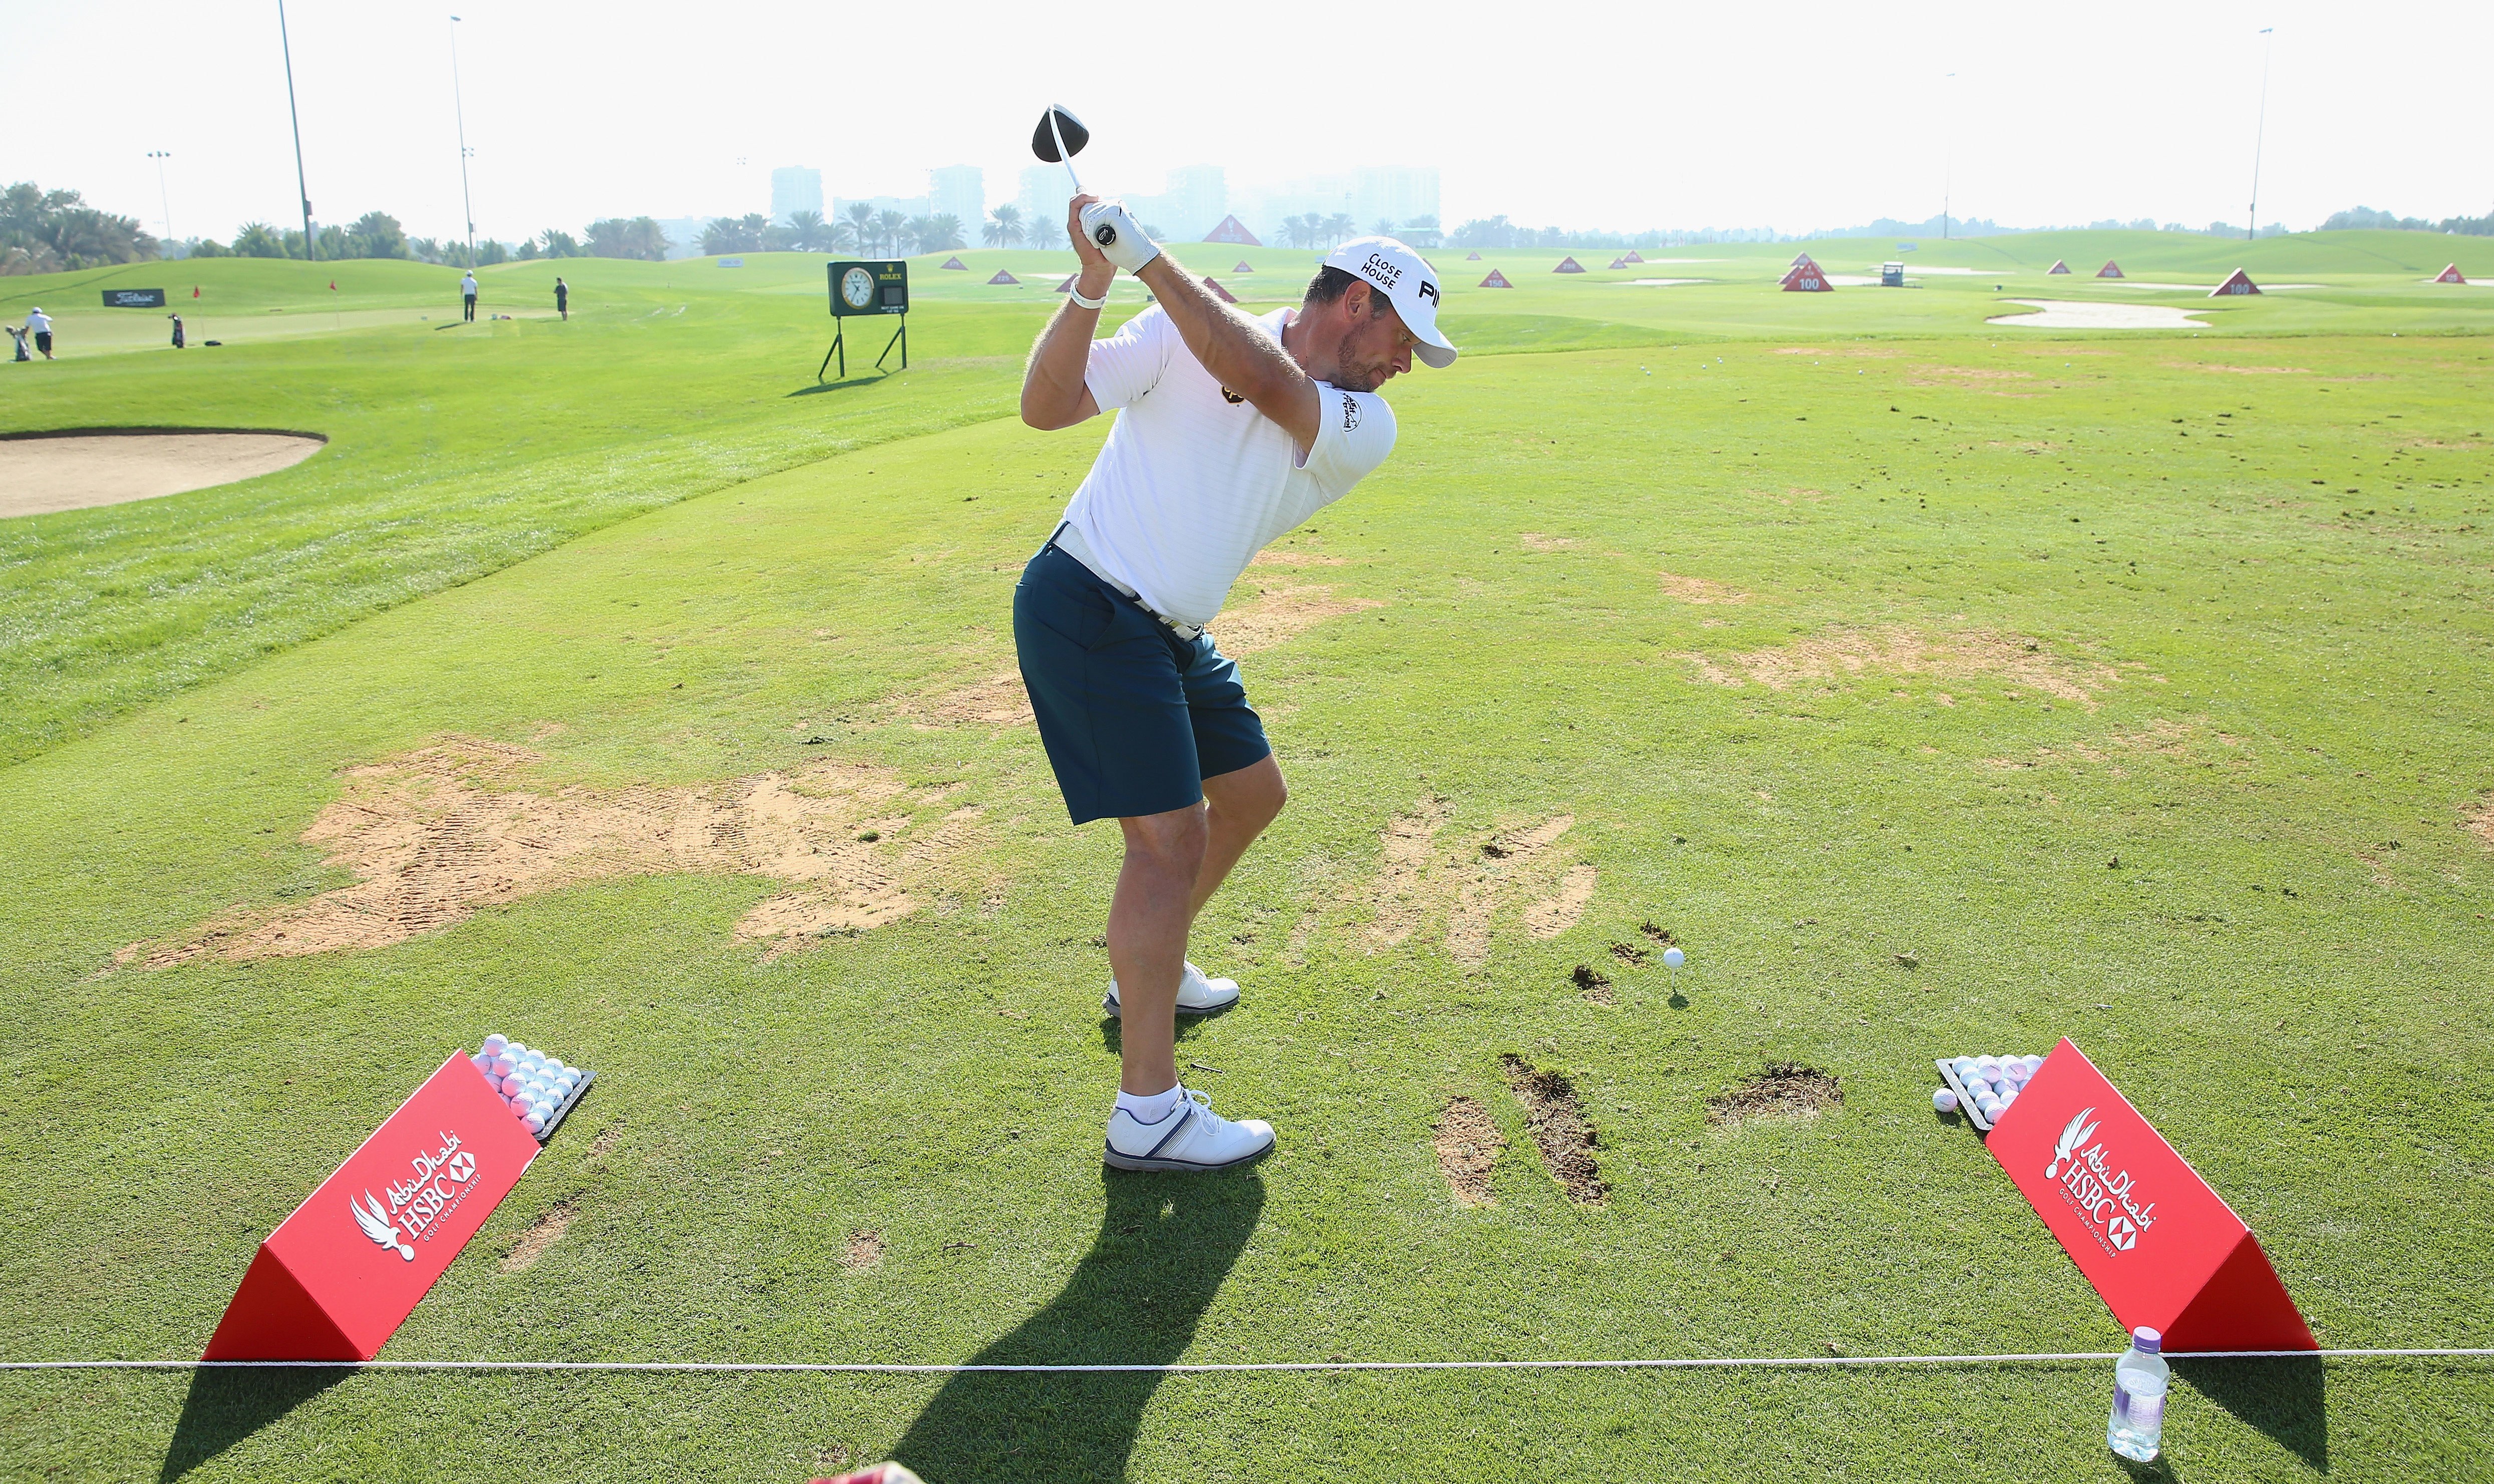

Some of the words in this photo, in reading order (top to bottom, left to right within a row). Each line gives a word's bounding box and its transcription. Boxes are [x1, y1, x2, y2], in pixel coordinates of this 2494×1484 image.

[1361, 262, 1396, 290] HOUSE
[1369, 253, 1402, 279] CLOSE
[1488, 279, 1503, 287] 150
[1799, 278, 1819, 290] 100
[2230, 283, 2250, 294] 100
[411, 1130, 462, 1182] Dhabi
[397, 1172, 455, 1241] HSBC
[423, 1222, 440, 1242] GOLF
[440, 1174, 482, 1223] CHAMPIONSHIP
[2060, 1159, 2117, 1224] HSBC
[2108, 1170, 2157, 1232] Dhabi
[2059, 1188, 2074, 1206] GOLF
[2073, 1207, 2117, 1259] CHAMPIONSHIP
